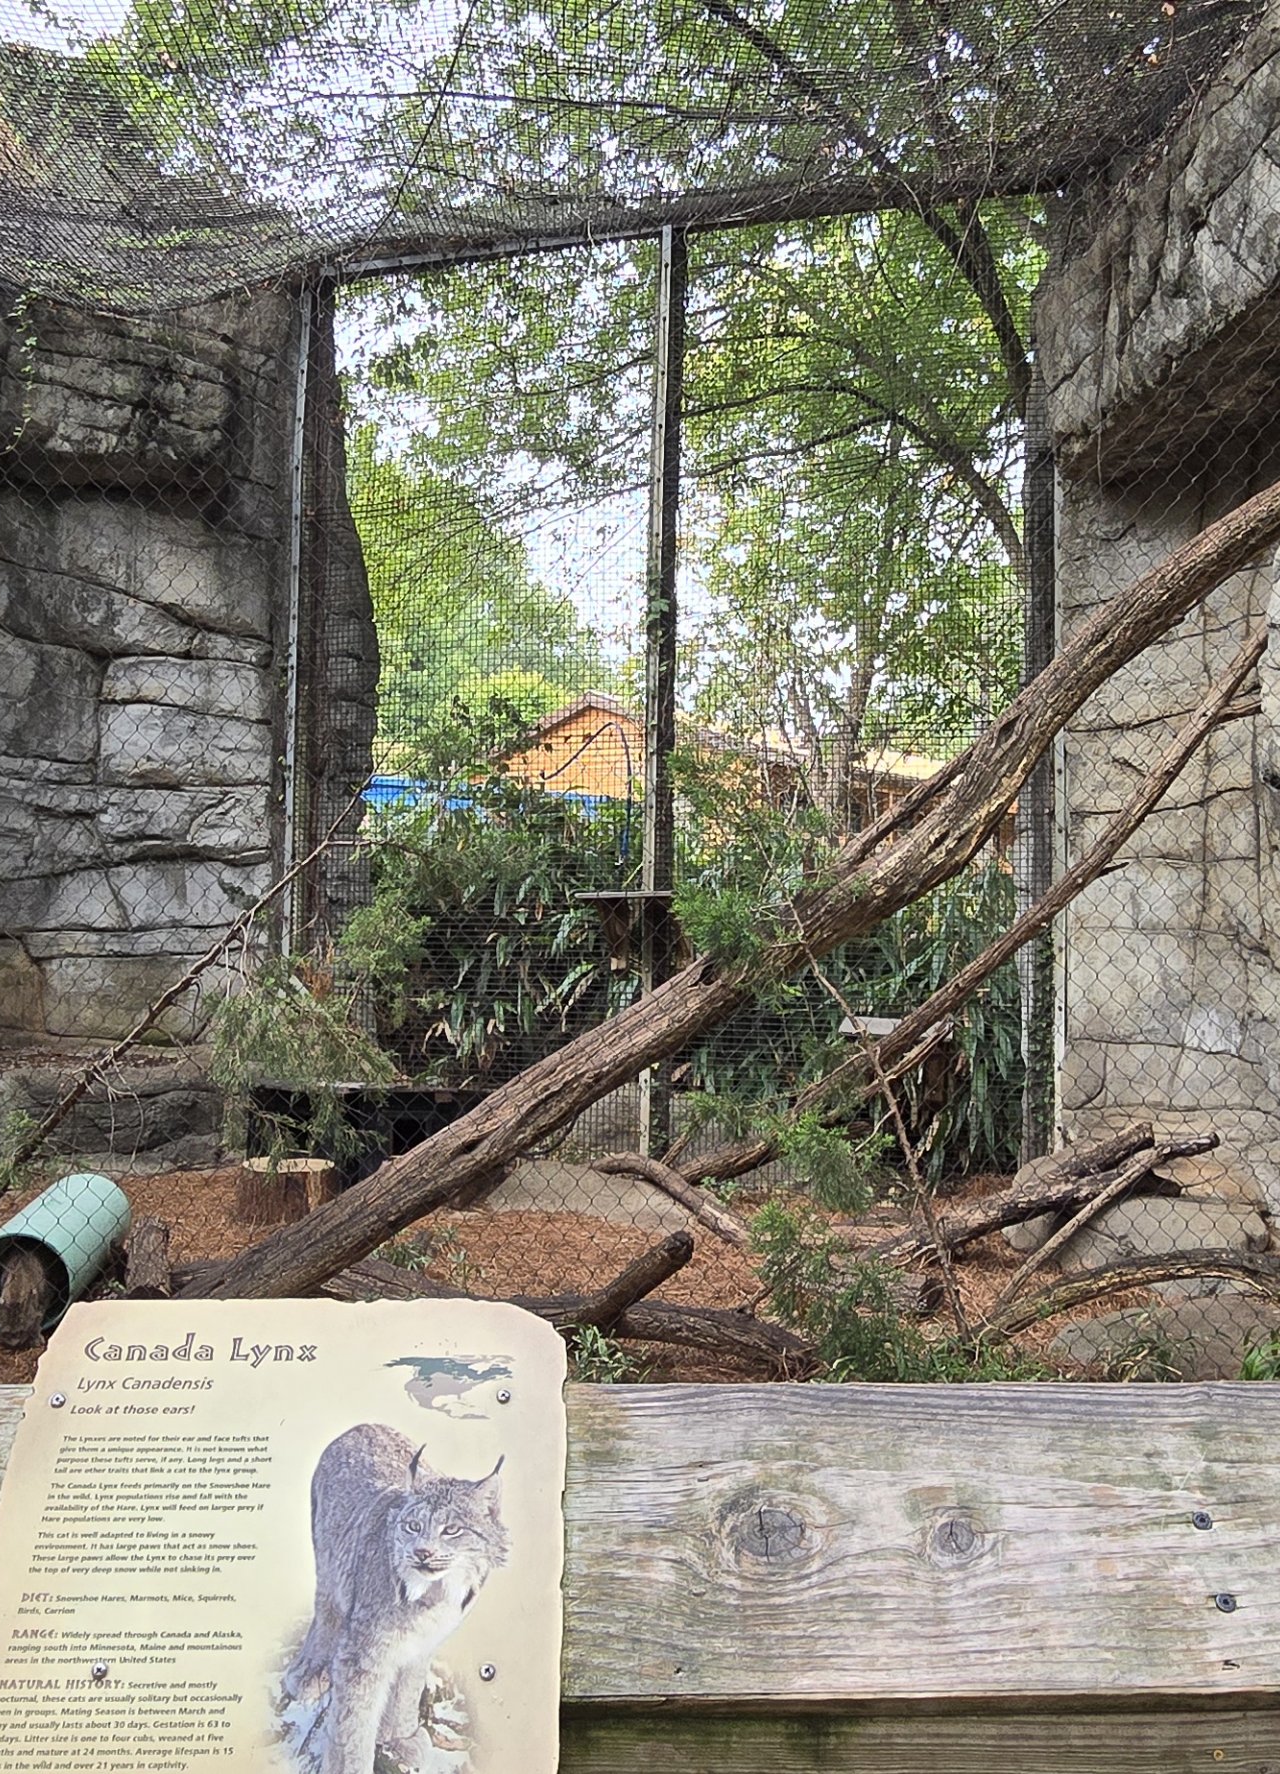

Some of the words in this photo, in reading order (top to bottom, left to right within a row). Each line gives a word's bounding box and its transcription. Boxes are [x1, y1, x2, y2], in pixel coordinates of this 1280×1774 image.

[84, 1332, 214, 1362] Canada
[229, 1337, 318, 1369] Lynx
[77, 1377, 117, 1394] Lynx
[122, 1376, 214, 1390] Canadensis
[70, 1404, 103, 1415] Look
[105, 1405, 120, 1415] at
[123, 1404, 159, 1415] those
[162, 1405, 196, 1415] ears!
[98, 1482, 118, 1491] Lynx
[41, 1515, 61, 1523] Hare
[62, 1515, 111, 1524] populations
[38, 1531, 54, 1539] This
[71, 1531, 79, 1539] is
[99, 1531, 134, 1540] adapted
[188, 1532, 216, 1540] snowy
[115, 1542, 137, 1552] large
[138, 1544, 161, 1552] paws
[163, 1542, 180, 1550] that
[32, 1554, 56, 1562] These
[57, 1554, 80, 1563] large
[80, 1555, 103, 1563] paws
[146, 1554, 166, 1563] Lynx
[178, 1553, 203, 1561] chase
[204, 1553, 215, 1561] its
[216, 1555, 236, 1563] prey
[44, 1566, 59, 1575] top
[60, 1565, 71, 1574] of
[71, 1567, 91, 1576] very
[91, 1566, 112, 1575] deep
[139, 1565, 162, 1573] while
[180, 1565, 211, 1575] sinking
[55, 1594, 99, 1602] Snowshoe
[44, 1606, 76, 1615] Carrion
[61, 1631, 91, 1641] Widely
[92, 1631, 123, 1640] spread
[124, 1631, 158, 1641] through
[160, 1630, 192, 1639] Canada
[193, 1630, 211, 1638] and
[7, 1644, 42, 1654] ranging
[43, 1643, 68, 1652] south
[139, 1643, 167, 1651] Maine
[168, 1643, 186, 1651] and
[186, 1643, 242, 1651] mountainous
[30, 1656, 39, 1664] in
[41, 1656, 56, 1664] the
[119, 1655, 148, 1664] United
[149, 1656, 176, 1664] States
[127, 1681, 168, 1689] Secretive
[169, 1680, 187, 1689] and
[188, 1680, 218, 1691] mostly
[42, 1694, 66, 1703] these
[67, 1695, 86, 1703] cats
[104, 1694, 136, 1704] usually
[137, 1694, 171, 1705] solitary
[172, 1694, 188, 1702] but
[189, 1693, 243, 1704] occasionally
[13, 1708, 23, 1716] in
[60, 1707, 93, 1718] Mating
[94, 1707, 127, 1716] Season
[128, 1707, 136, 1716] is
[137, 1707, 177, 1715] between
[178, 1707, 206, 1715] March
[208, 1706, 226, 1715] and
[9, 1720, 28, 1729] and
[28, 1720, 61, 1731] usually
[61, 1720, 83, 1729] lasts
[85, 1720, 112, 1729] about
[113, 1720, 126, 1729] 30
[152, 1720, 196, 1729] Gestation
[197, 1720, 205, 1728] is
[207, 1720, 219, 1728] 63
[221, 1720, 231, 1728] to
[24, 1734, 50, 1743] Litter
[51, 1734, 69, 1743] size
[70, 1734, 78, 1743] is
[99, 1735, 109, 1743] to
[111, 1734, 131, 1742] four
[158, 1733, 194, 1742] weaned
[195, 1734, 205, 1742] at
[207, 1733, 224, 1742] five
[16, 1747, 35, 1756] and
[70, 1748, 81, 1756] at
[82, 1747, 95, 1756] 24
[134, 1747, 173, 1758] Average
[174, 1746, 210, 1757] lifespan
[212, 1746, 221, 1755] is
[223, 1746, 234, 1756] 15
[3, 1761, 13, 1770] in
[15, 1761, 30, 1770] the
[53, 1760, 73, 1770] and
[73, 1762, 95, 1770] over
[96, 1761, 108, 1770] 21
[109, 1762, 134, 1772] years
[136, 1760, 146, 1769] in
